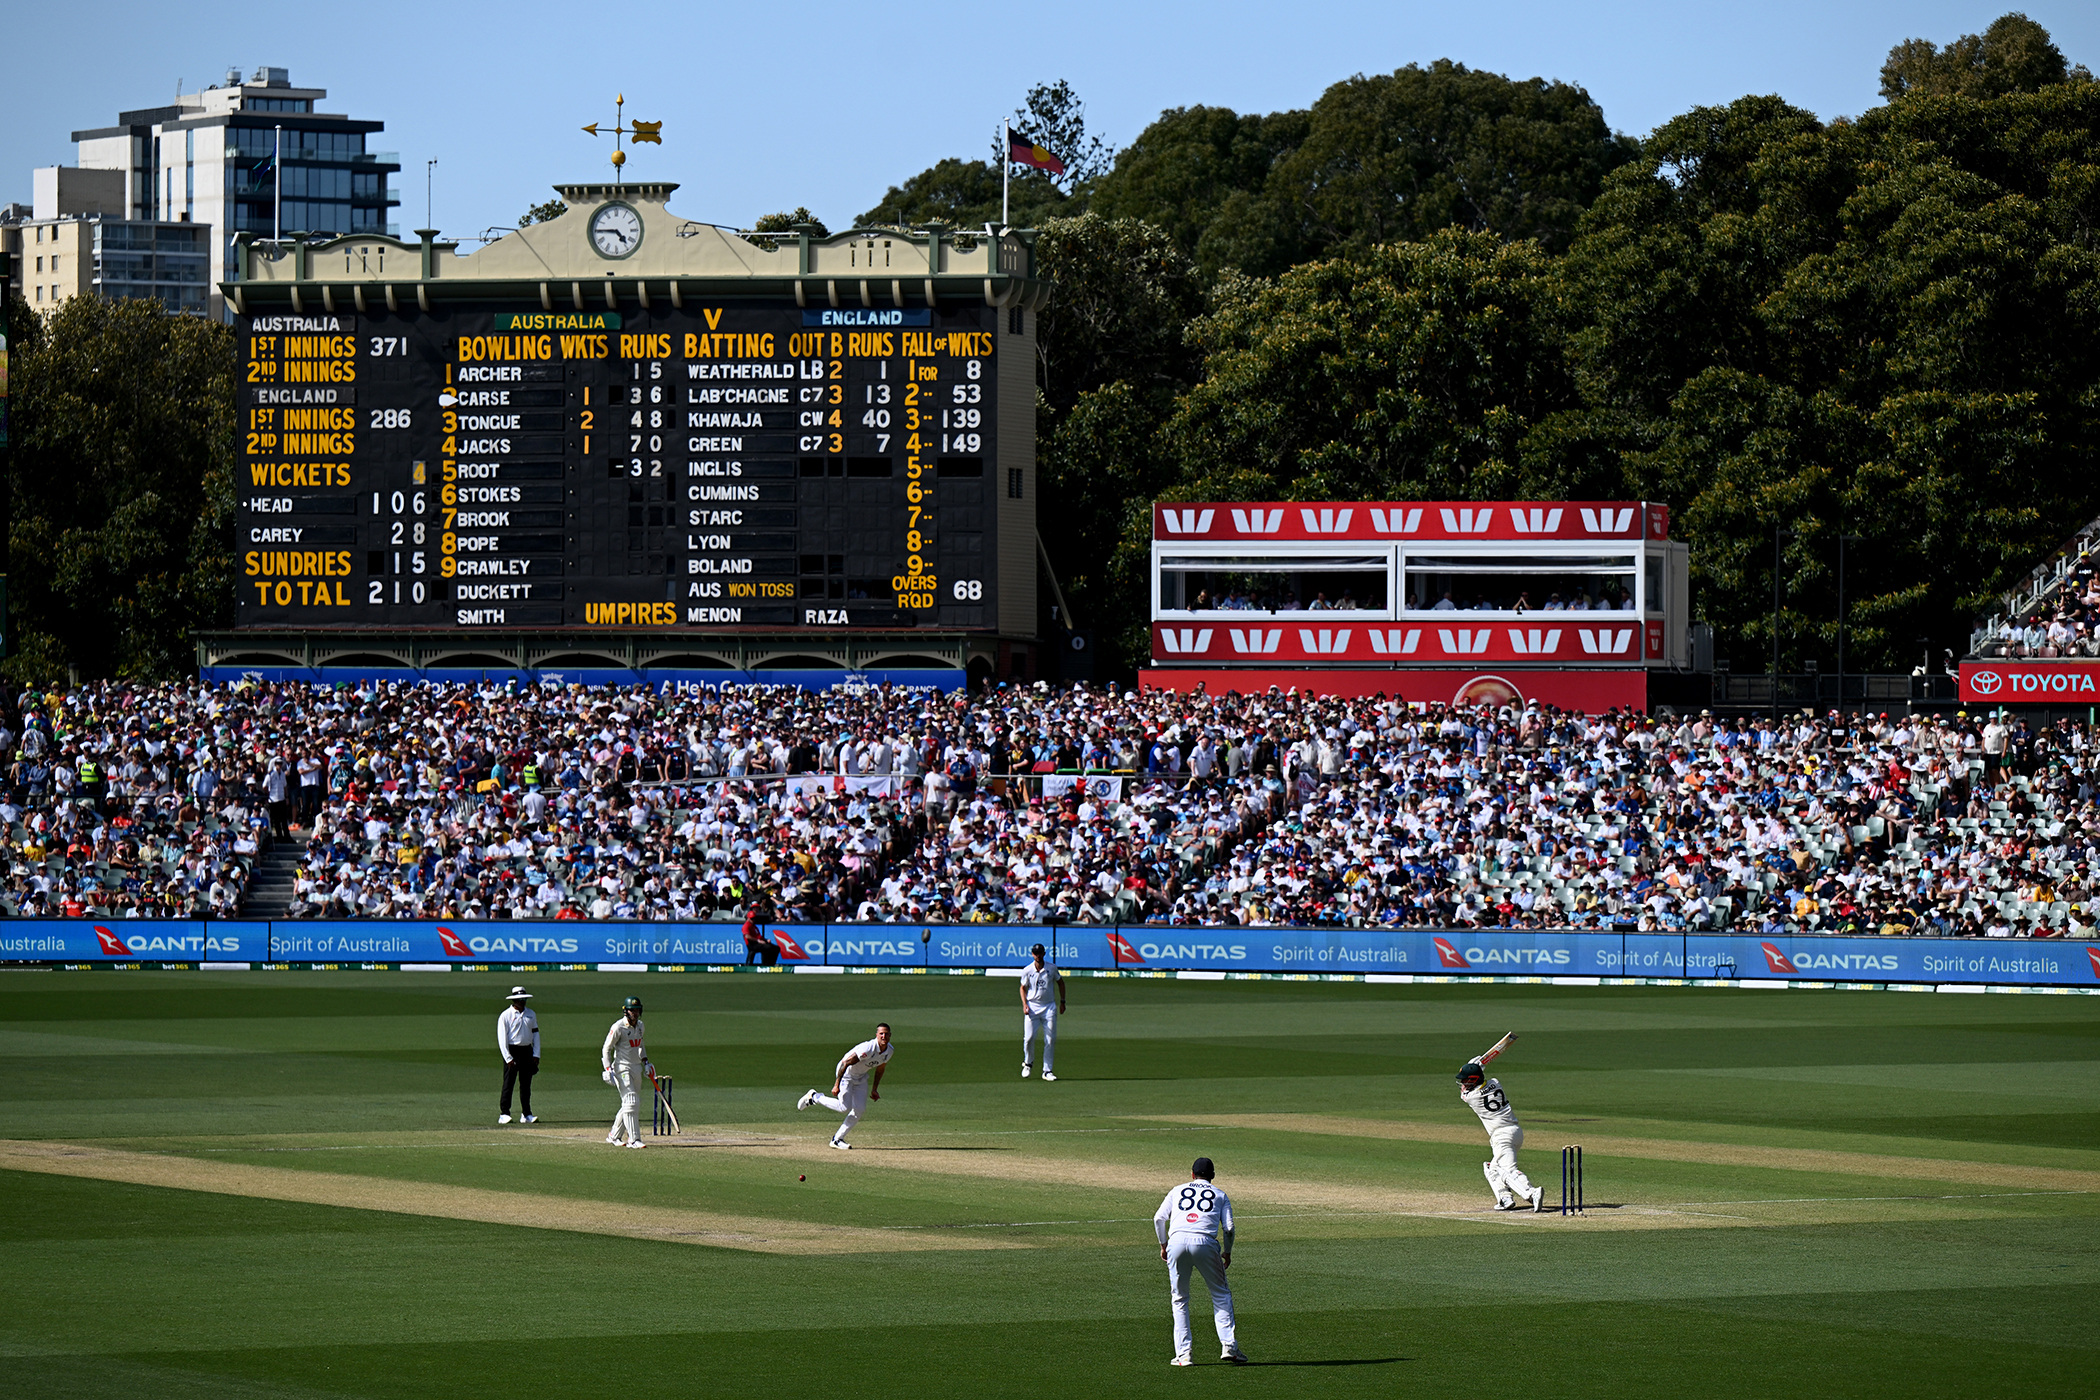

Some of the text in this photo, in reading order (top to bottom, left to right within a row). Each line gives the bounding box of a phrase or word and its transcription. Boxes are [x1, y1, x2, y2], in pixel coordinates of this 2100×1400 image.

[252, 317, 340, 332] AUSTRALIA
[510, 314, 606, 329] AUSTRALIA
[703, 308, 723, 331] V
[821, 311, 903, 326] ENGLAND
[284, 335, 356, 358] INNINGS
[370, 336, 408, 357] 371
[458, 333, 672, 362] BOWLING WKTS RUNS
[684, 332, 894, 359] BATTING OUT B RUNS
[902, 332, 993, 358] FALL OF WKTS
[284, 360, 356, 382] INNINGS
[445, 361, 662, 385] 1 ARCHER 15
[688, 360, 887, 380] WEATHERALD LB 2 1
[909, 359, 981, 382] 1 FOR 8
[258, 389, 338, 404] ENGLAND
[458, 391, 510, 406] CARSE
[584, 387, 589, 405] 1
[630, 386, 662, 404] 36
[801, 387, 824, 403] C7
[829, 385, 842, 404] 3
[866, 385, 891, 404] 13
[904, 383, 982, 406] 2 53
[283, 408, 355, 431] INNINGS
[370, 409, 411, 429] 286
[442, 410, 662, 433] 3 TONGUE 2 48
[688, 409, 891, 428] KHAWAJA CW 4 40
[905, 408, 981, 430] 3 139
[283, 432, 355, 454] INNINGS
[441, 435, 662, 457] 4 JACKS 1 70
[688, 433, 890, 453] GREEN C7 3 7
[906, 432, 981, 454] 4 149
[250, 462, 426, 487] WICKETS 4
[442, 460, 457, 481] 5
[458, 463, 500, 479] ROOT
[688, 461, 742, 476] INGLIS
[906, 456, 922, 479] 5
[251, 491, 426, 514] HEAD 106
[441, 483, 521, 505] 6 STOKES
[688, 485, 759, 501] CUMMINS
[906, 481, 923, 504] 6
[441, 508, 510, 529] 7 BROOK
[689, 510, 743, 526] STARC
[908, 506, 922, 528] 7
[251, 522, 425, 544] CAREY 28
[441, 531, 499, 555] 8 POPE
[688, 535, 731, 550] LYON
[906, 529, 922, 552] 8
[245, 550, 425, 576] SUNDRIES 15
[440, 556, 531, 578] 9 CRAWLEY
[688, 559, 752, 574] BOLAND
[906, 554, 923, 577] 9
[254, 581, 425, 606] TOTAL 210
[457, 584, 532, 600] DUCKETT
[688, 582, 795, 598] AUS WON TOSS
[892, 575, 982, 600] OVERS 68
[457, 609, 505, 624] SMITH
[585, 602, 849, 625] UMPIRES MENON RAZA
[2008, 674, 2096, 692] TOYOTA
[126, 935, 240, 952] QANTAS
[270, 936, 410, 955] Spirit of Australia
[469, 937, 579, 953] QANTAS
[605, 937, 744, 957] Spirit of Australia
[803, 940, 915, 956] QANTAS
[940, 941, 983, 961] Spirit
[986, 941, 1003, 957] of
[1140, 942, 1246, 960] QANTAS
[1272, 946, 1408, 964] Spirit of Australia
[1464, 947, 1570, 964] QANTAS
[1596, 949, 1735, 968] Spirit of Australia
[1793, 952, 1898, 970] QANTAS
[1923, 954, 2059, 975] Spirit of Australia
[1178, 1187, 1216, 1213] 88
